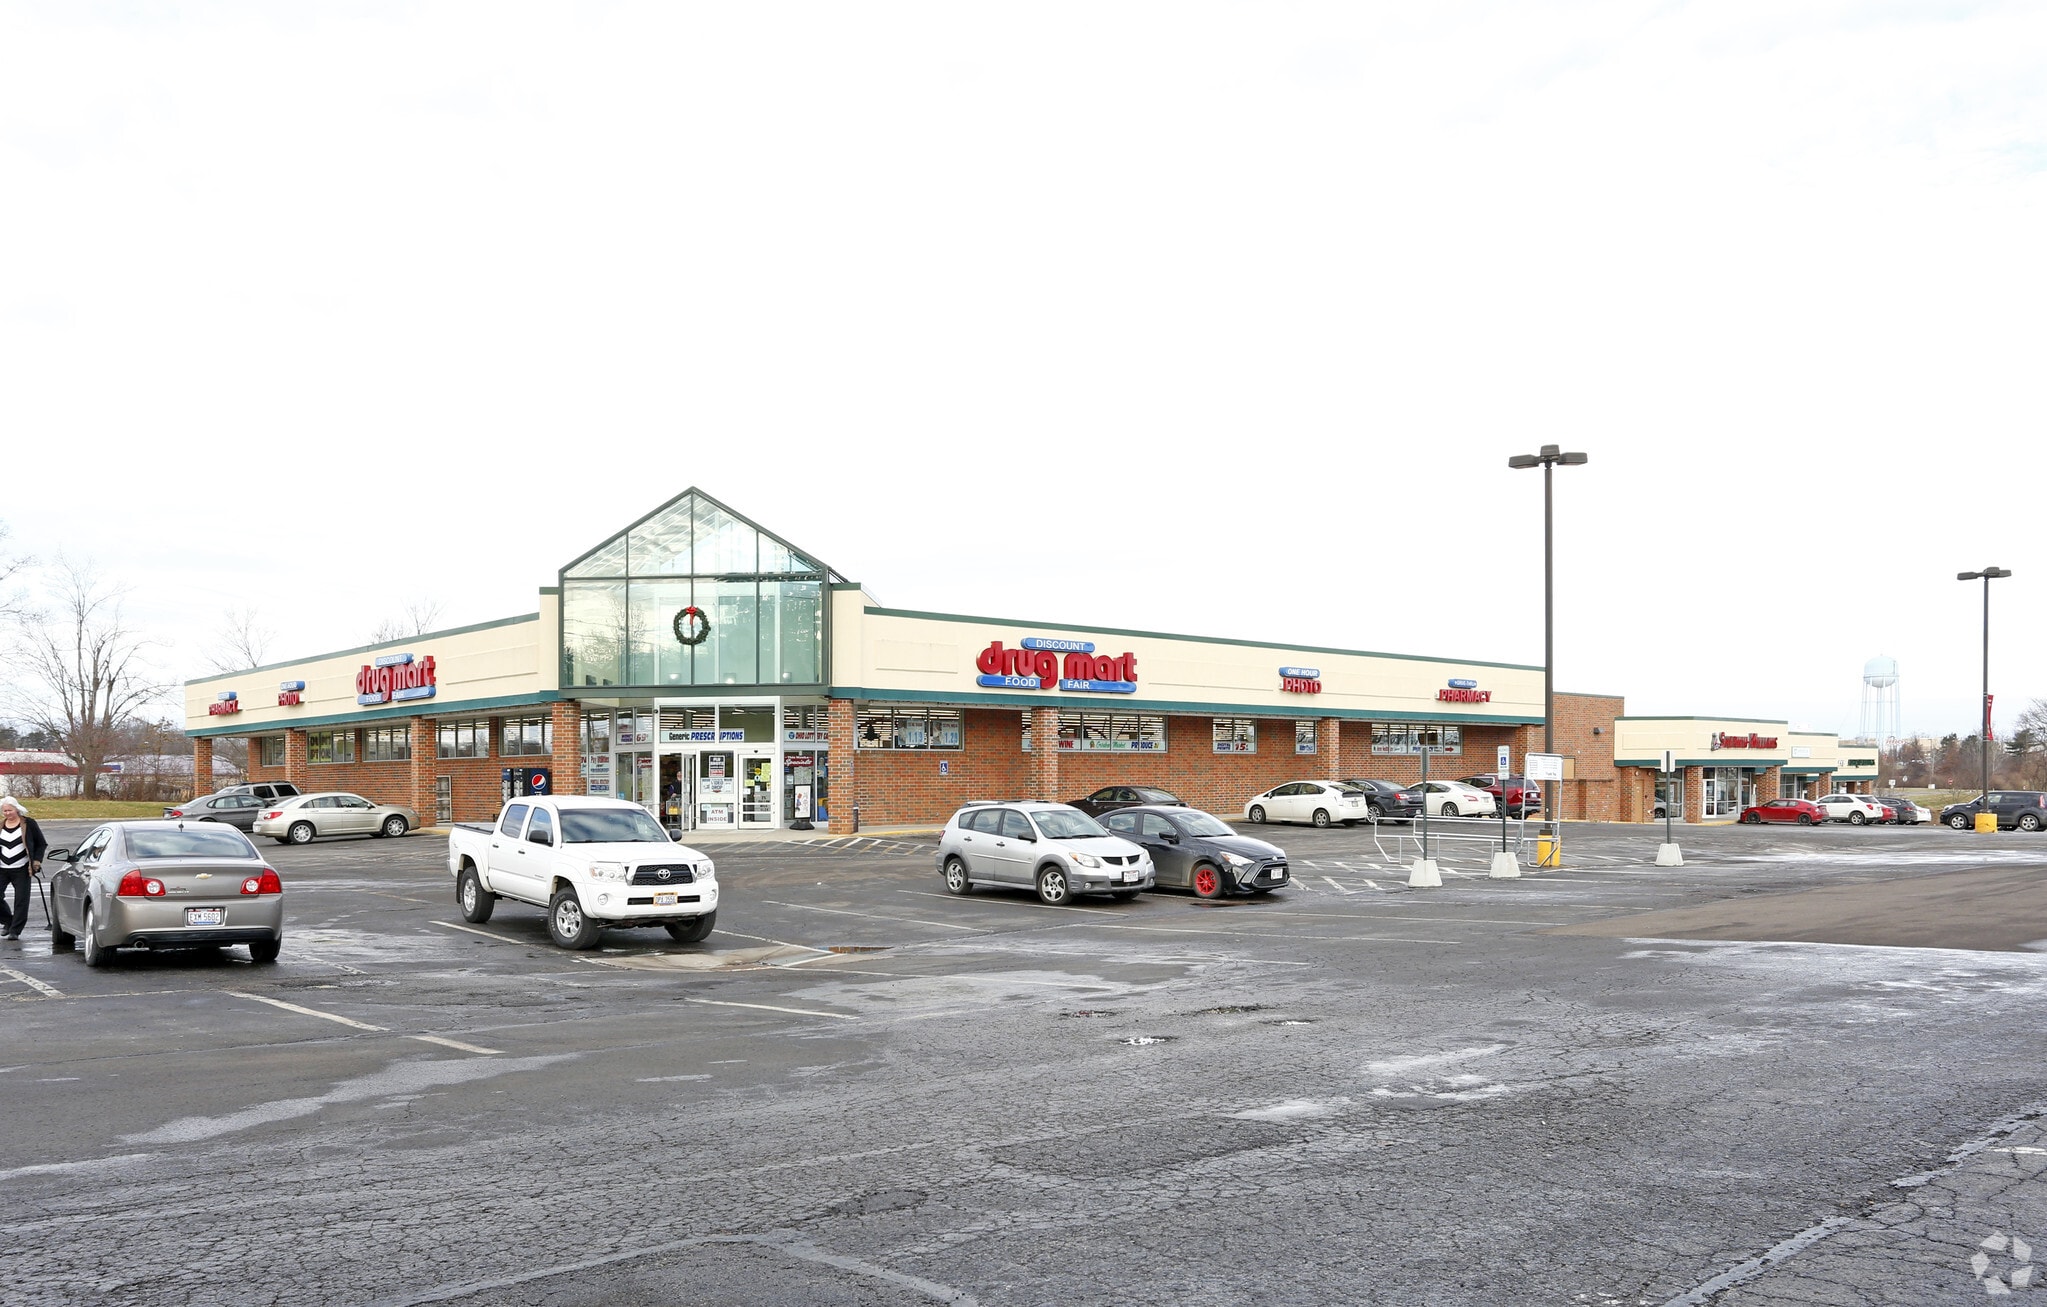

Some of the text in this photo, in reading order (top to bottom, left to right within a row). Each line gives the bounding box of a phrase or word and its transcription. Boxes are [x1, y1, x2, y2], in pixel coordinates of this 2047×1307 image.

[1036, 640, 1085, 651] DISCOUNT
[976, 641, 1137, 689] drug mart
[356, 656, 436, 702] drug mart
[1287, 668, 1318, 677] ONE HOUR
[1005, 677, 1090, 690] FOOD FAIR
[1283, 677, 1322, 694] PHOTO
[278, 691, 300, 706] PHOTO
[1439, 689, 1492, 702] PHARMACY
[209, 700, 239, 716] PHARMACY
[668, 731, 743, 741] Generic PRESCRIPTIONS
[1058, 740, 1074, 748] WINE
